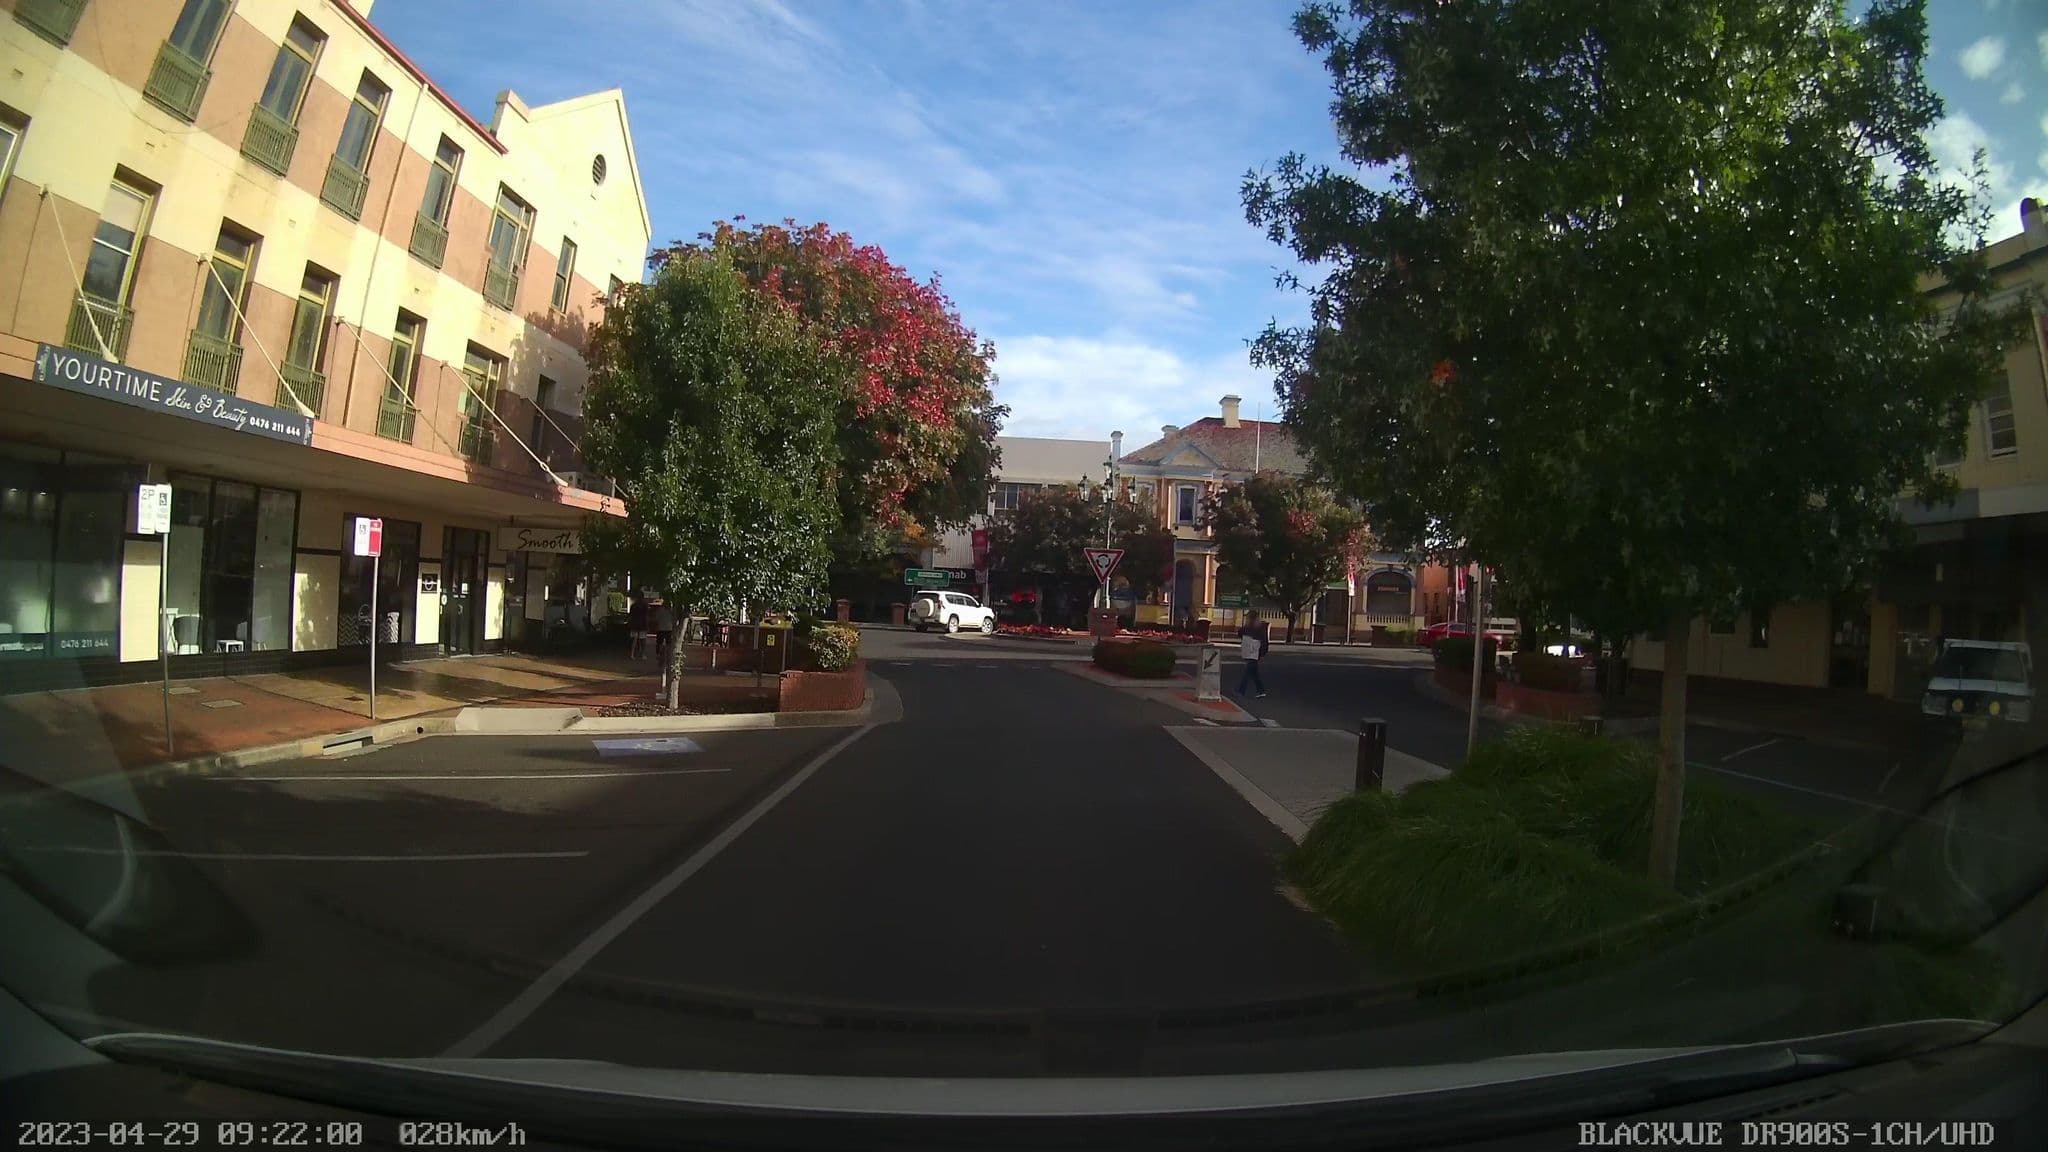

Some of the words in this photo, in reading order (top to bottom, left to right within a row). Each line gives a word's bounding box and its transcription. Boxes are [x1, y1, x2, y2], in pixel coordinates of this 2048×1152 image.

[53, 352, 163, 402] YOURTIME
[165, 386, 193, 411] Skin
[195, 393, 213, 414] &
[212, 398, 248, 431] Beauty
[249, 416, 270, 430] 0476
[271, 422, 284, 433] 211
[518, 528, 573, 549] Smooth
[949, 570, 967, 579] nab
